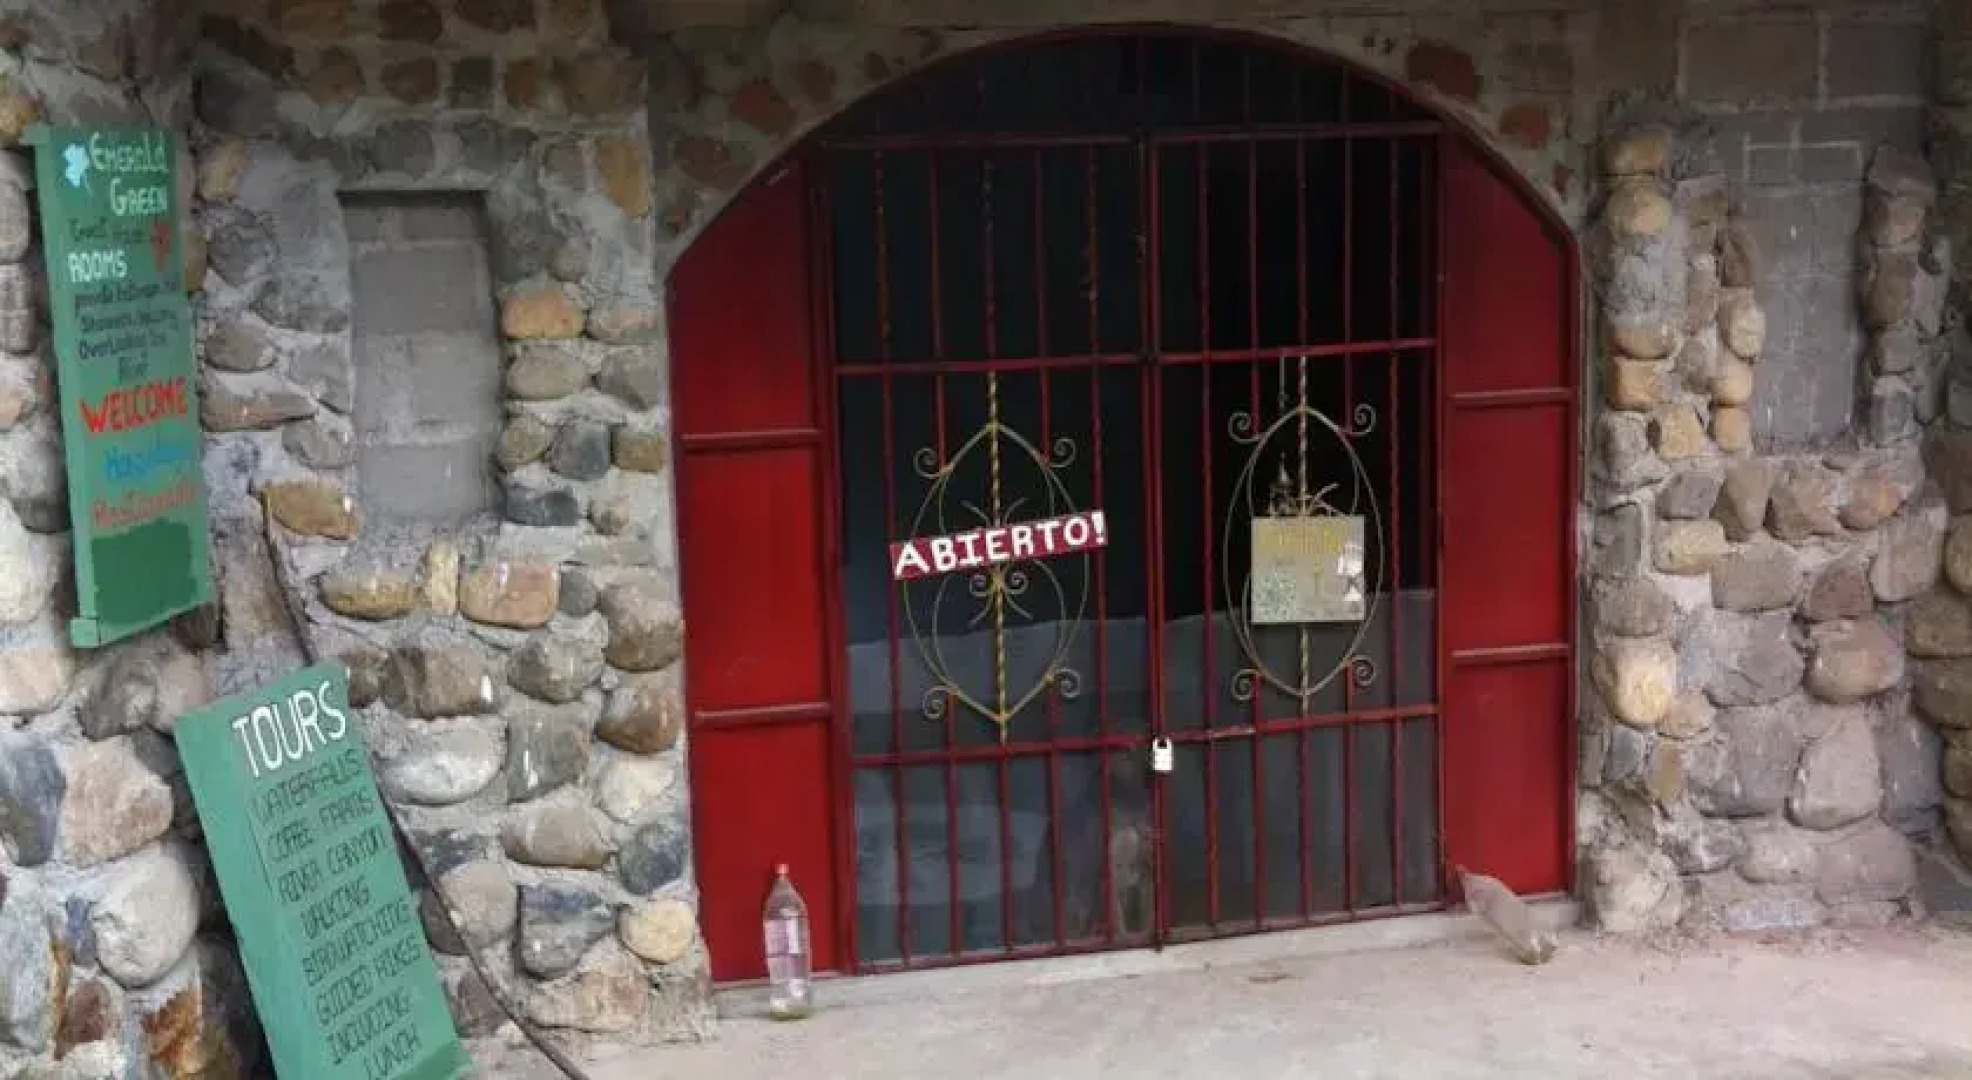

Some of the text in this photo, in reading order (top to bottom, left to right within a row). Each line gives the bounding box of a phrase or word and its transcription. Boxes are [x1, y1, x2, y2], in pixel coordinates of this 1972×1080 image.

[67, 249, 128, 283] ROOMS
[78, 376, 189, 434] WELCOME
[893, 510, 1106, 579] ABIERTO!
[231, 680, 347, 779] TOURS
[253, 747, 363, 827] WATERFALLS
[316, 963, 374, 1027] GUIDED
